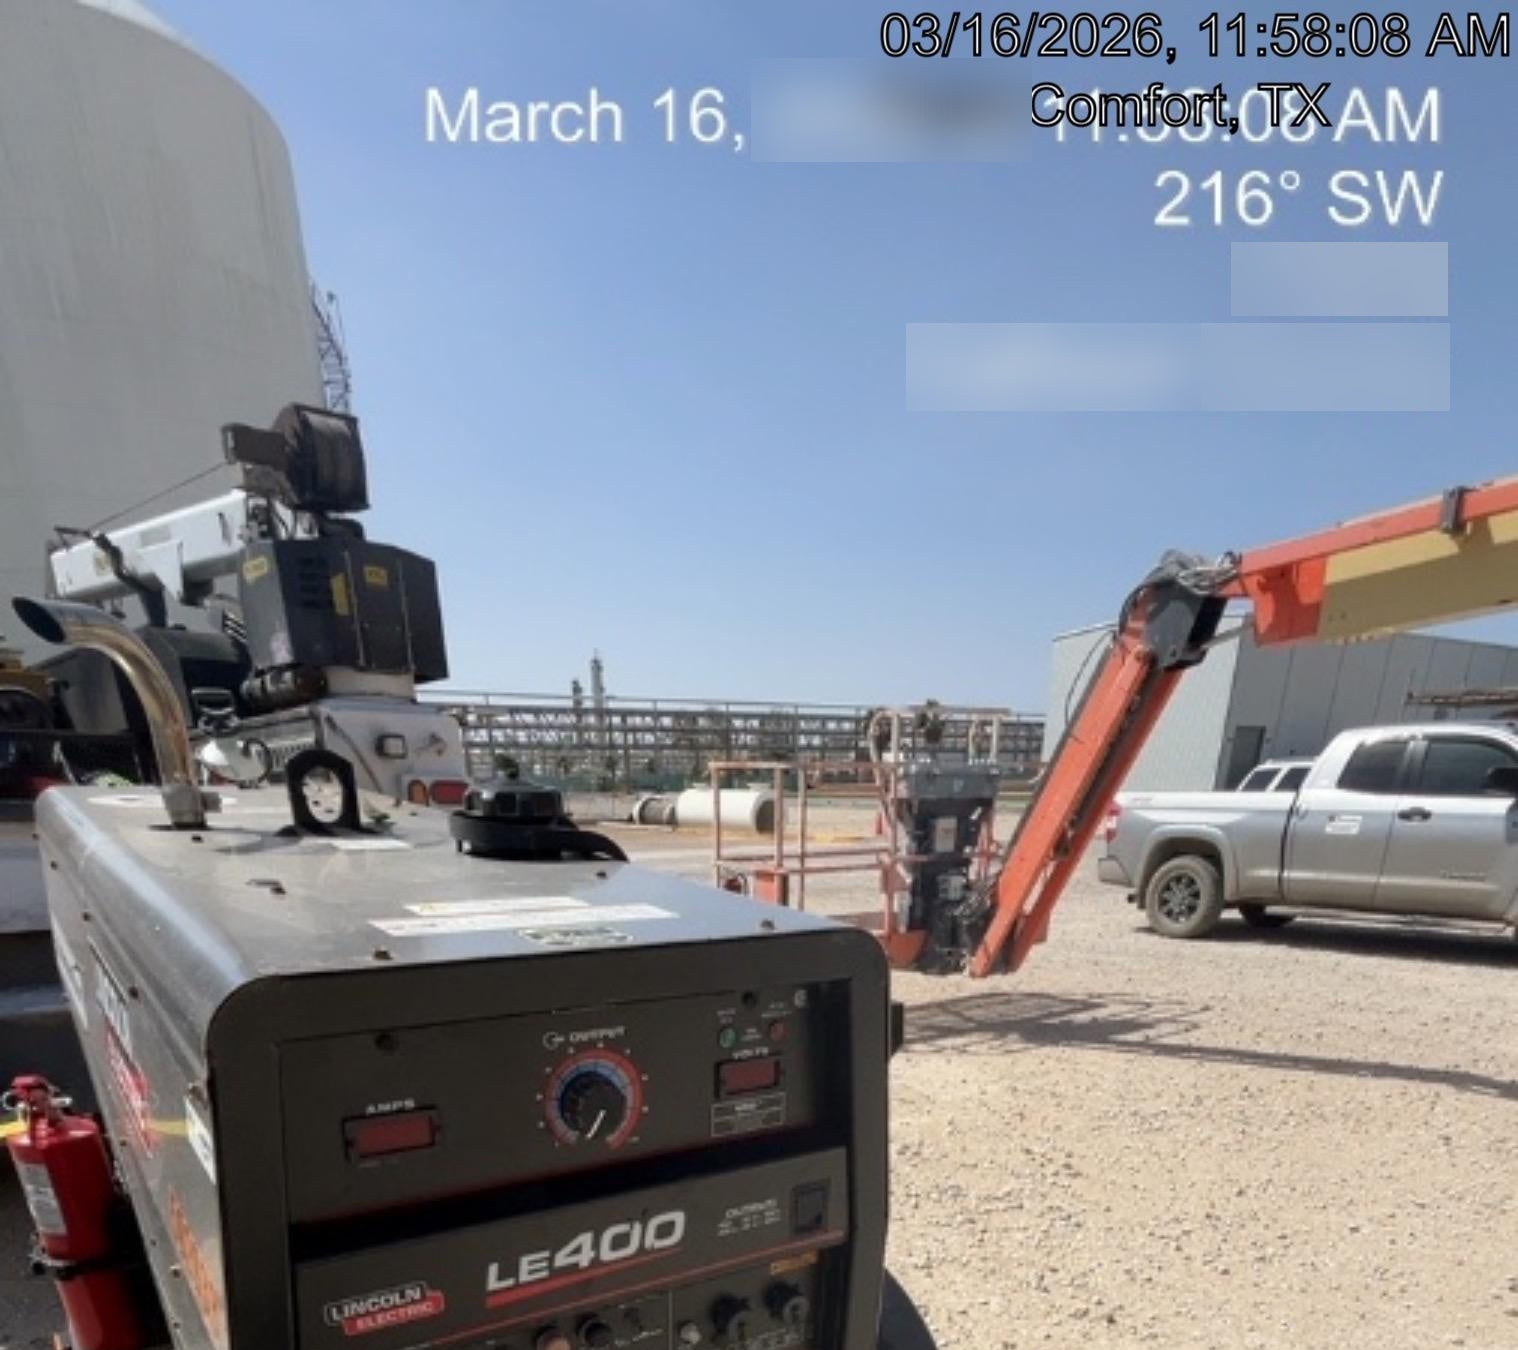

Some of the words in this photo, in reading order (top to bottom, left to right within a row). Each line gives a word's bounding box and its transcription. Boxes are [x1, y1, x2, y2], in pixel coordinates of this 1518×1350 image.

[487, 1210, 686, 1292] LE400
[331, 1285, 423, 1322] LINCOLN
[355, 1301, 435, 1331] ELECTRIC
